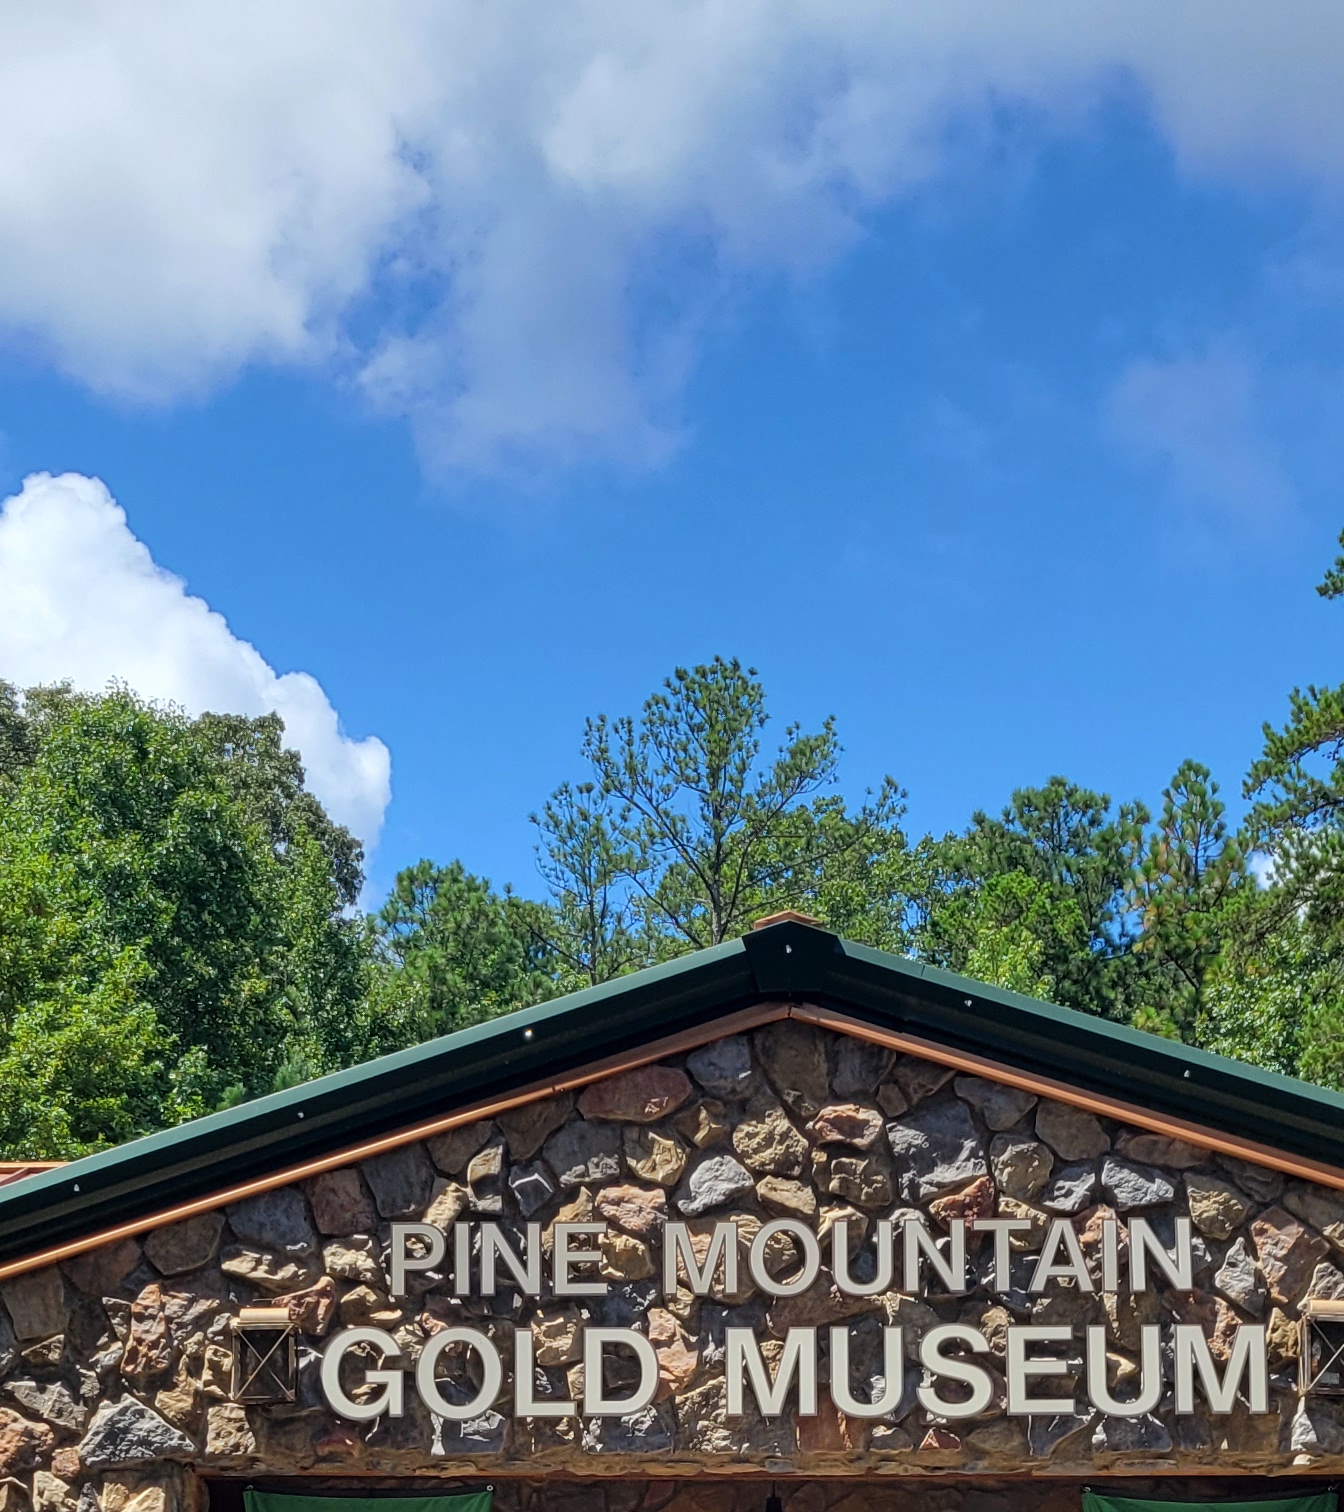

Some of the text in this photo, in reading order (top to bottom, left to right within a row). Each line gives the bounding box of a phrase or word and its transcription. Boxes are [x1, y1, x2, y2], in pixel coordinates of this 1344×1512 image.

[389, 1215, 1193, 1297] PINE MOUNTAIN
[320, 1322, 1269, 1421] GOLD MUSEUM
